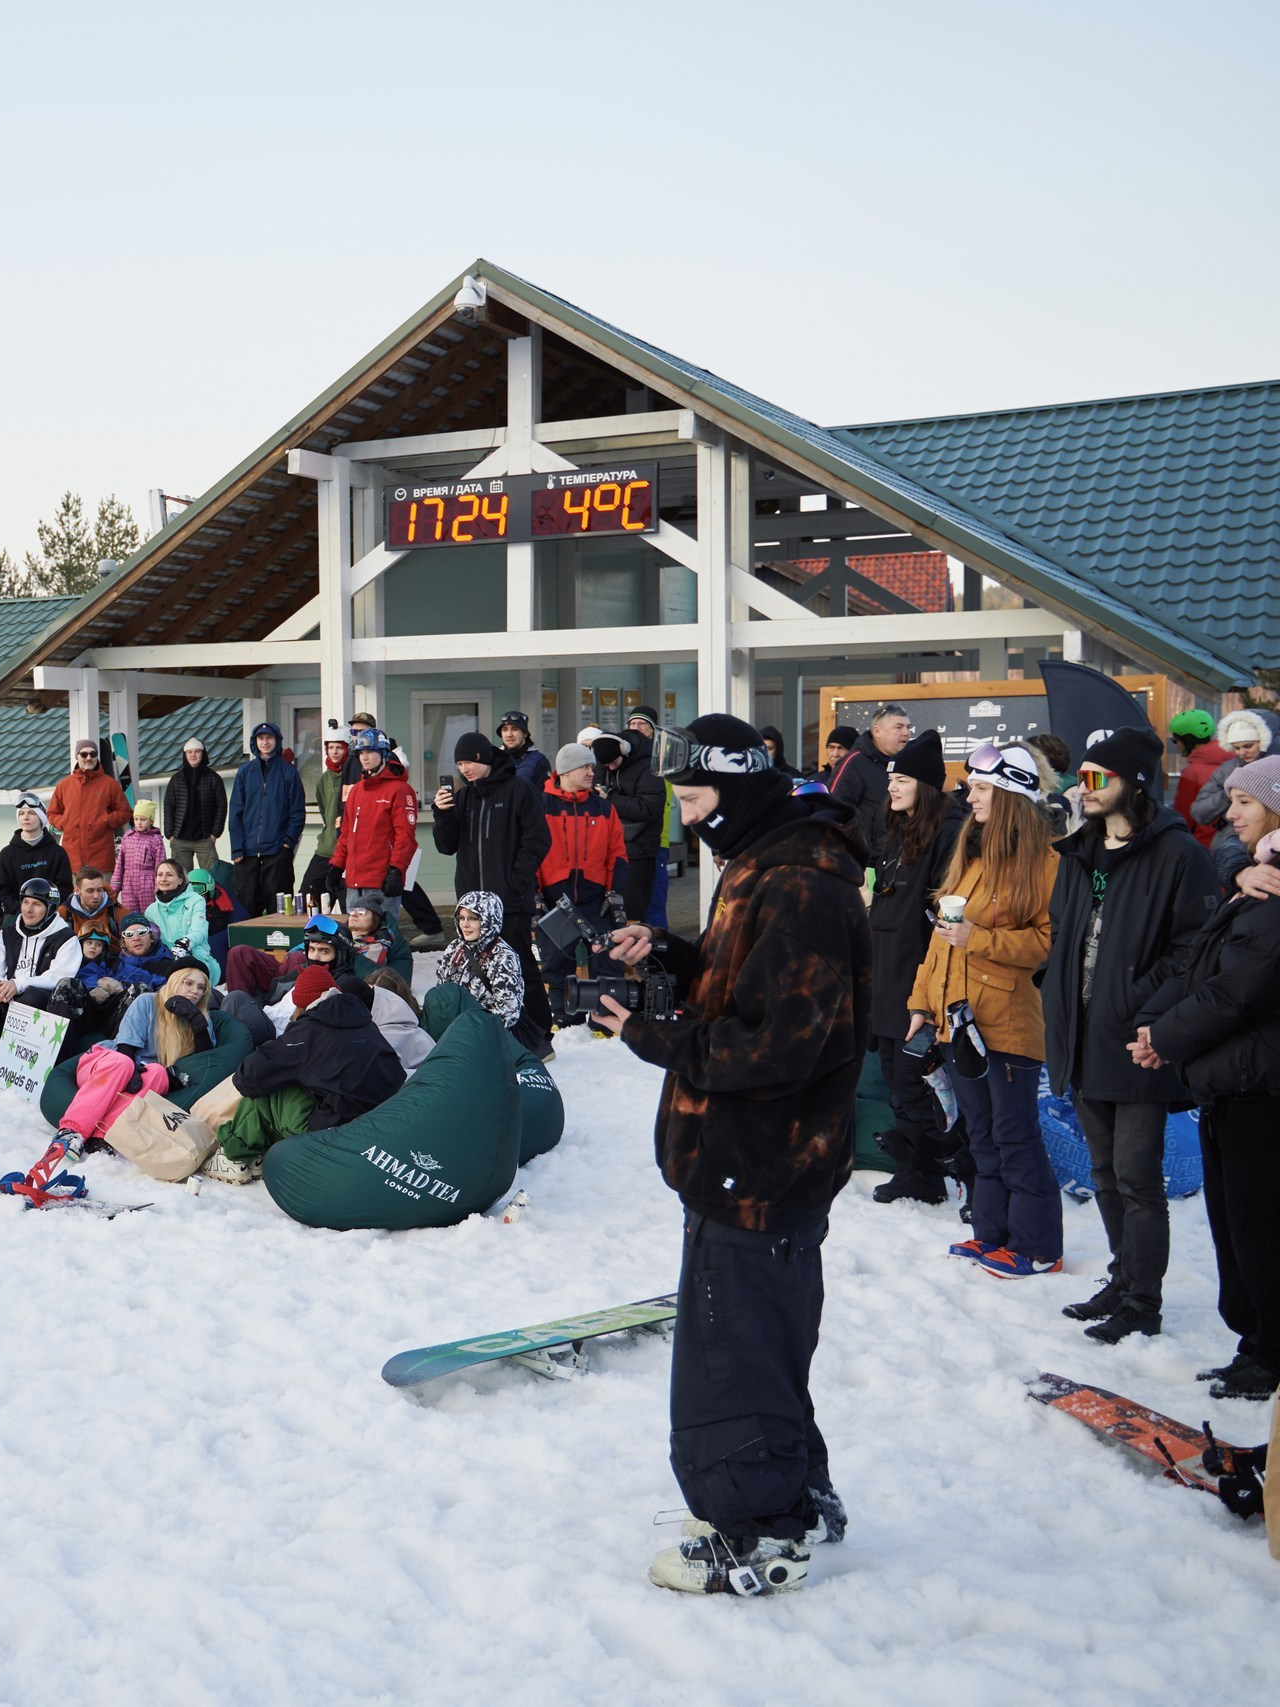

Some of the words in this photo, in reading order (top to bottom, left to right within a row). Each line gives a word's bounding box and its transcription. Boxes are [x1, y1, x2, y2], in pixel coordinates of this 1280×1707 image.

[559, 469, 638, 486] ТЕМПЕРАТУРА
[413, 485, 449, 498] ВРЕМЯ
[455, 483, 483, 496] ДАТА
[360, 1144, 430, 1189] AHMAD
[427, 1179, 461, 1203] TEA
[384, 1178, 421, 1200] LONDON
